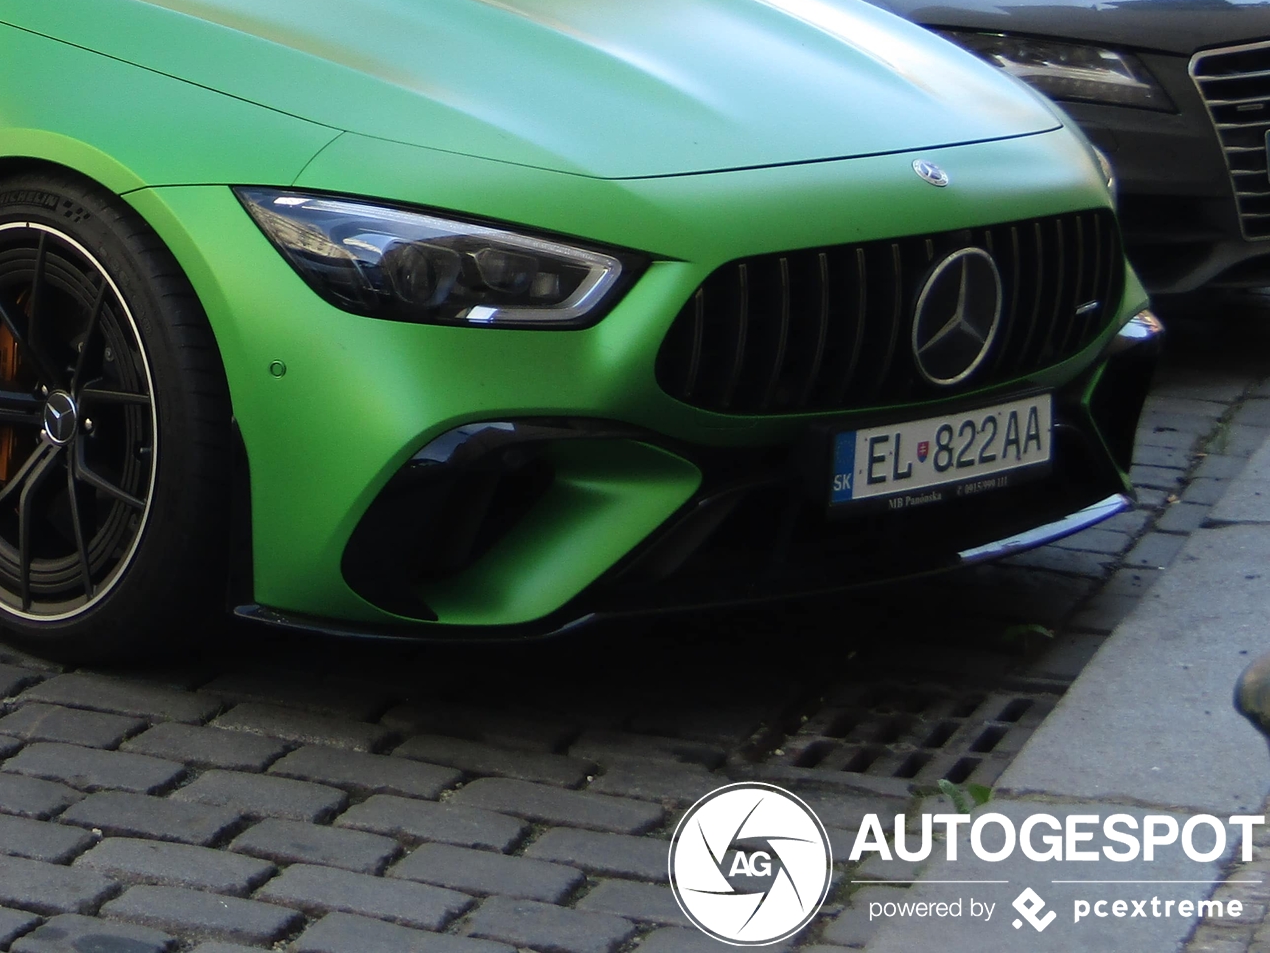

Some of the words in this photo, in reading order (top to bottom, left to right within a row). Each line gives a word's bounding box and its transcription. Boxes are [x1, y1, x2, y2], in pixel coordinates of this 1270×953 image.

[833, 472, 852, 491] SK
[867, 433, 913, 485] EL
[933, 405, 1042, 473] 822AA
[888, 497, 904, 509] MB
